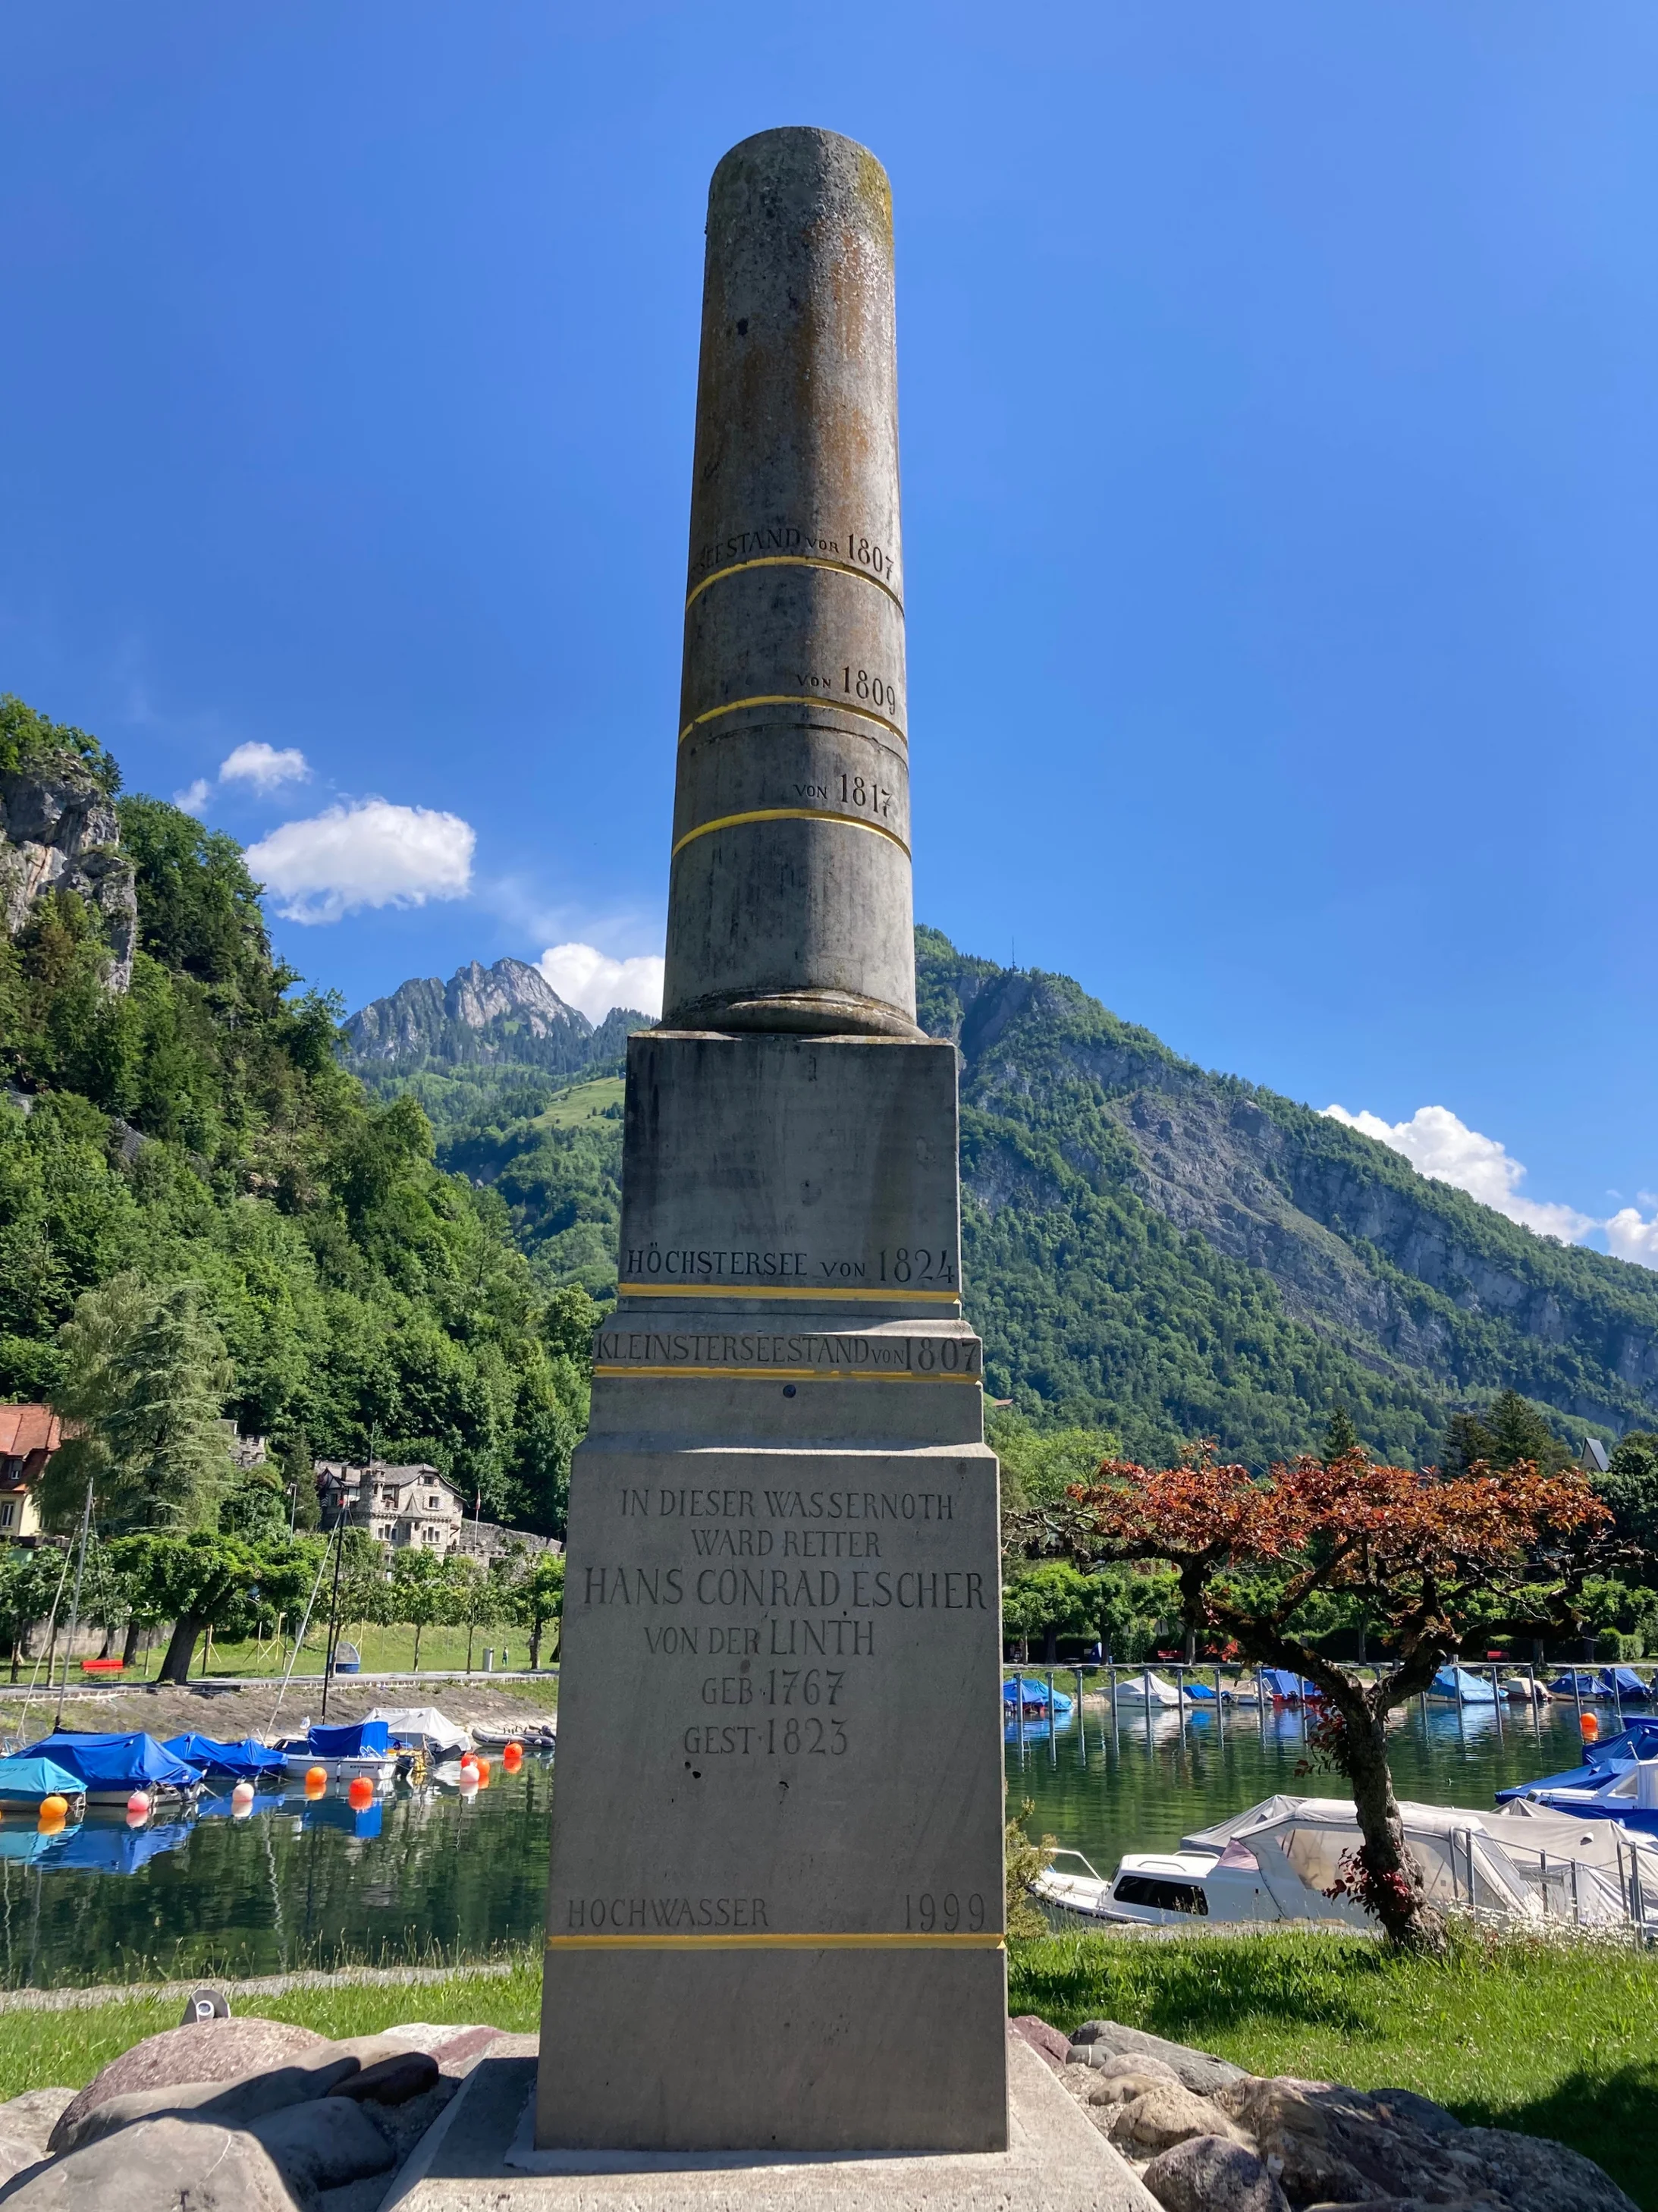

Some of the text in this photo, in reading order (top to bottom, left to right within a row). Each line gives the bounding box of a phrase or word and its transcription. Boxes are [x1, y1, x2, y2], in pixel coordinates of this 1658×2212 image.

[805, 537, 840, 553] VOR
[848, 533, 894, 581] 1807
[796, 666, 896, 715] VON 1809
[793, 773, 893, 818] VON 1817
[626, 1242, 955, 1284] HÖCHSTERSEE VON 1824
[595, 1333, 981, 1372] KLEINSTERSEESTAND VON 1807
[622, 1489, 953, 1520] IN DIESER WASSERNOTH
[691, 1529, 881, 1557] WARD RETTER
[584, 1567, 988, 1610] HANS CONRAD ESCHER
[644, 1619, 875, 1656] VON DER LINTH
[768, 1668, 846, 1706] 1767
[767, 1717, 848, 1755] 1823
[568, 1893, 985, 1932] HOCHWASSER 1999
